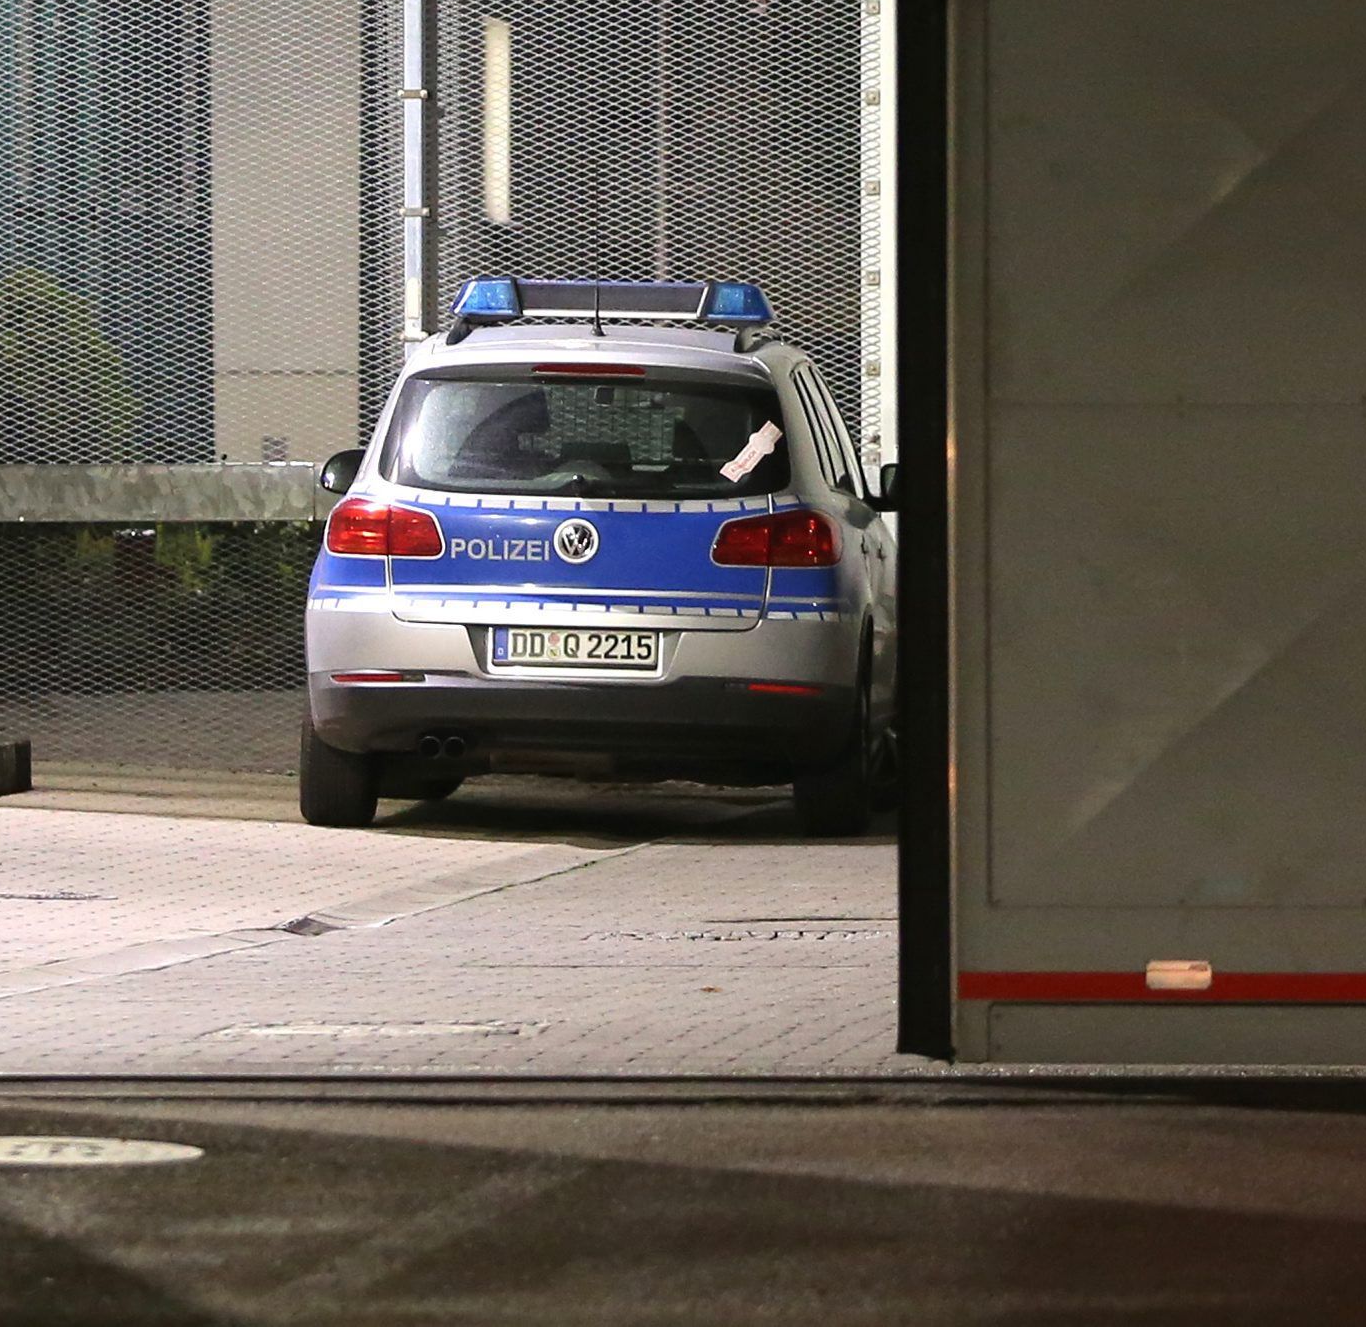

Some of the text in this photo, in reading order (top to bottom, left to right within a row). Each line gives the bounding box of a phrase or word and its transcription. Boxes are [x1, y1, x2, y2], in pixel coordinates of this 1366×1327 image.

[450, 538, 550, 561] POLIZEI
[511, 632, 653, 660] DD Q 2215
